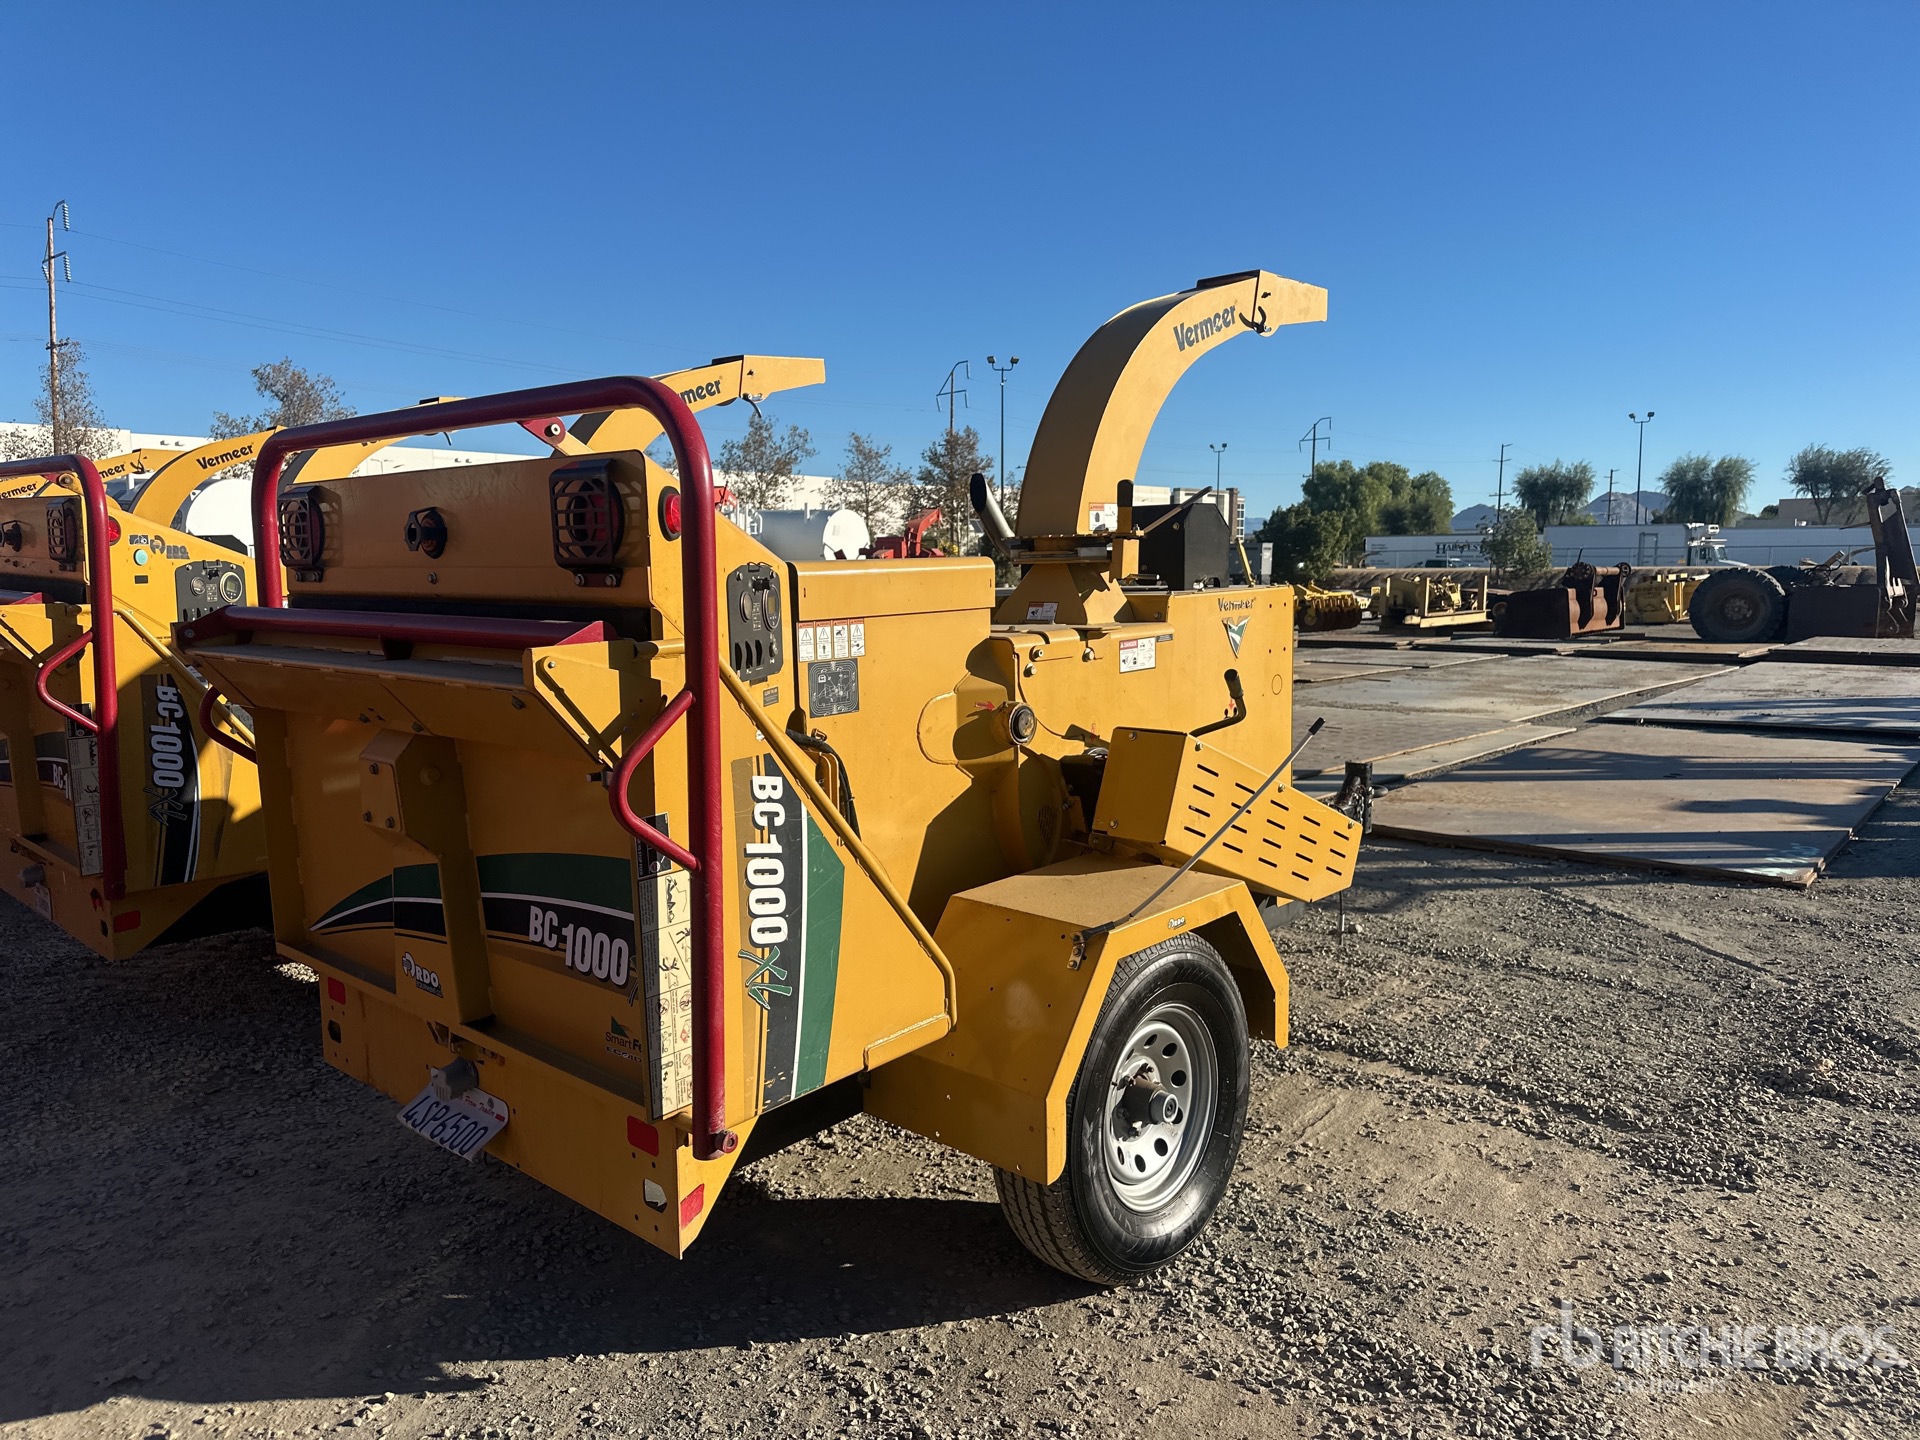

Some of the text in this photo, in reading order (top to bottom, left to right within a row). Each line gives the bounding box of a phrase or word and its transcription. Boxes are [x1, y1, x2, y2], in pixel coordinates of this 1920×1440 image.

[1173, 304, 1236, 352] Vermeer
[678, 379, 721, 404] meer
[196, 444, 254, 470] Vermeer
[99, 463, 126, 479] meer
[0, 483, 37, 499] ermeer
[1217, 597, 1255, 612] Vermeer
[150, 722, 185, 788] 1000
[737, 775, 793, 1011] BC 1000 XL
[528, 904, 559, 950] BC
[562, 922, 630, 987] 1000
[605, 1031, 642, 1052] SmartF
[402, 1095, 489, 1156] 4SP6500
